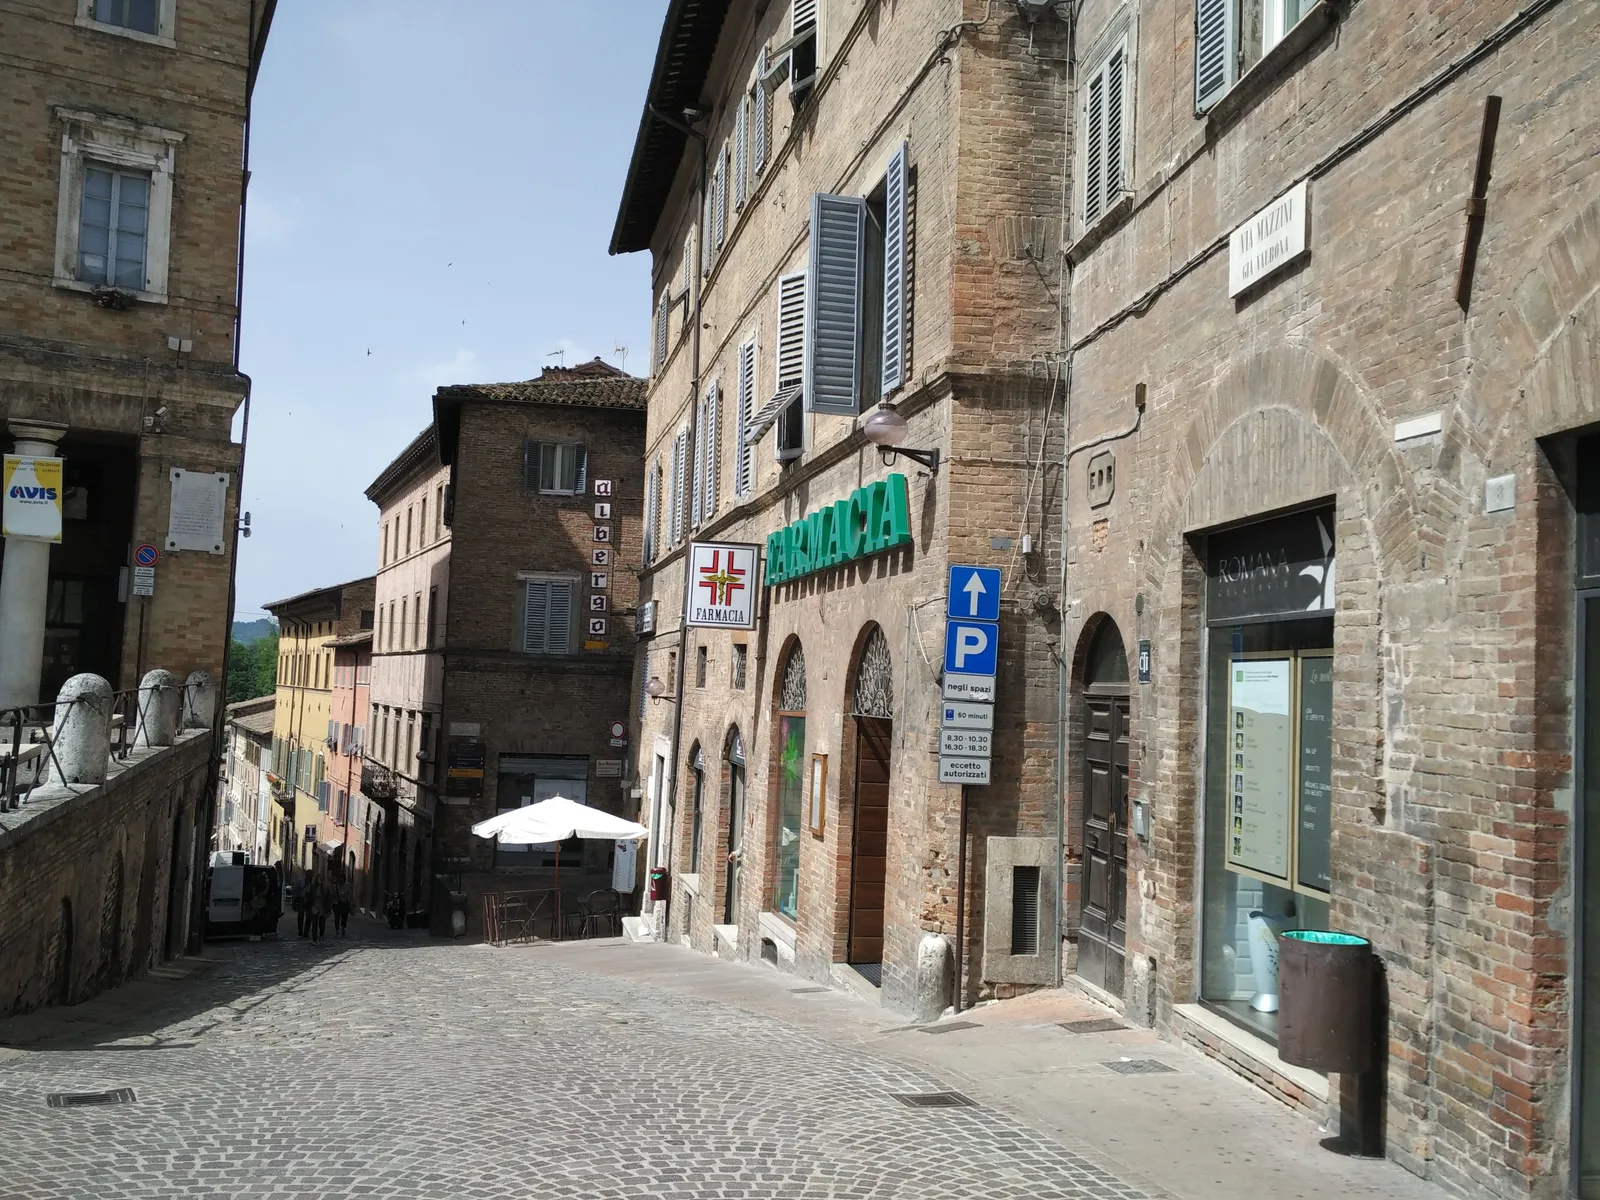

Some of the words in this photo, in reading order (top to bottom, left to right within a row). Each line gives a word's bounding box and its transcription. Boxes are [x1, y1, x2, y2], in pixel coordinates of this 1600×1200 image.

[1241, 228, 1253, 254] VIA
[1257, 198, 1293, 241] MAZZINI
[1257, 236, 1289, 271] VALBONA
[10, 486, 57, 500] AVIS
[764, 473, 911, 586] FARMACIA
[591, 481, 610, 633] albergo
[1219, 548, 1290, 583] ROMANA
[695, 608, 744, 622] FARMACIA
[955, 626, 988, 669] P
[947, 684, 968, 692] negli
[970, 685, 991, 693] spazi
[943, 771, 987, 779] autorizzati
